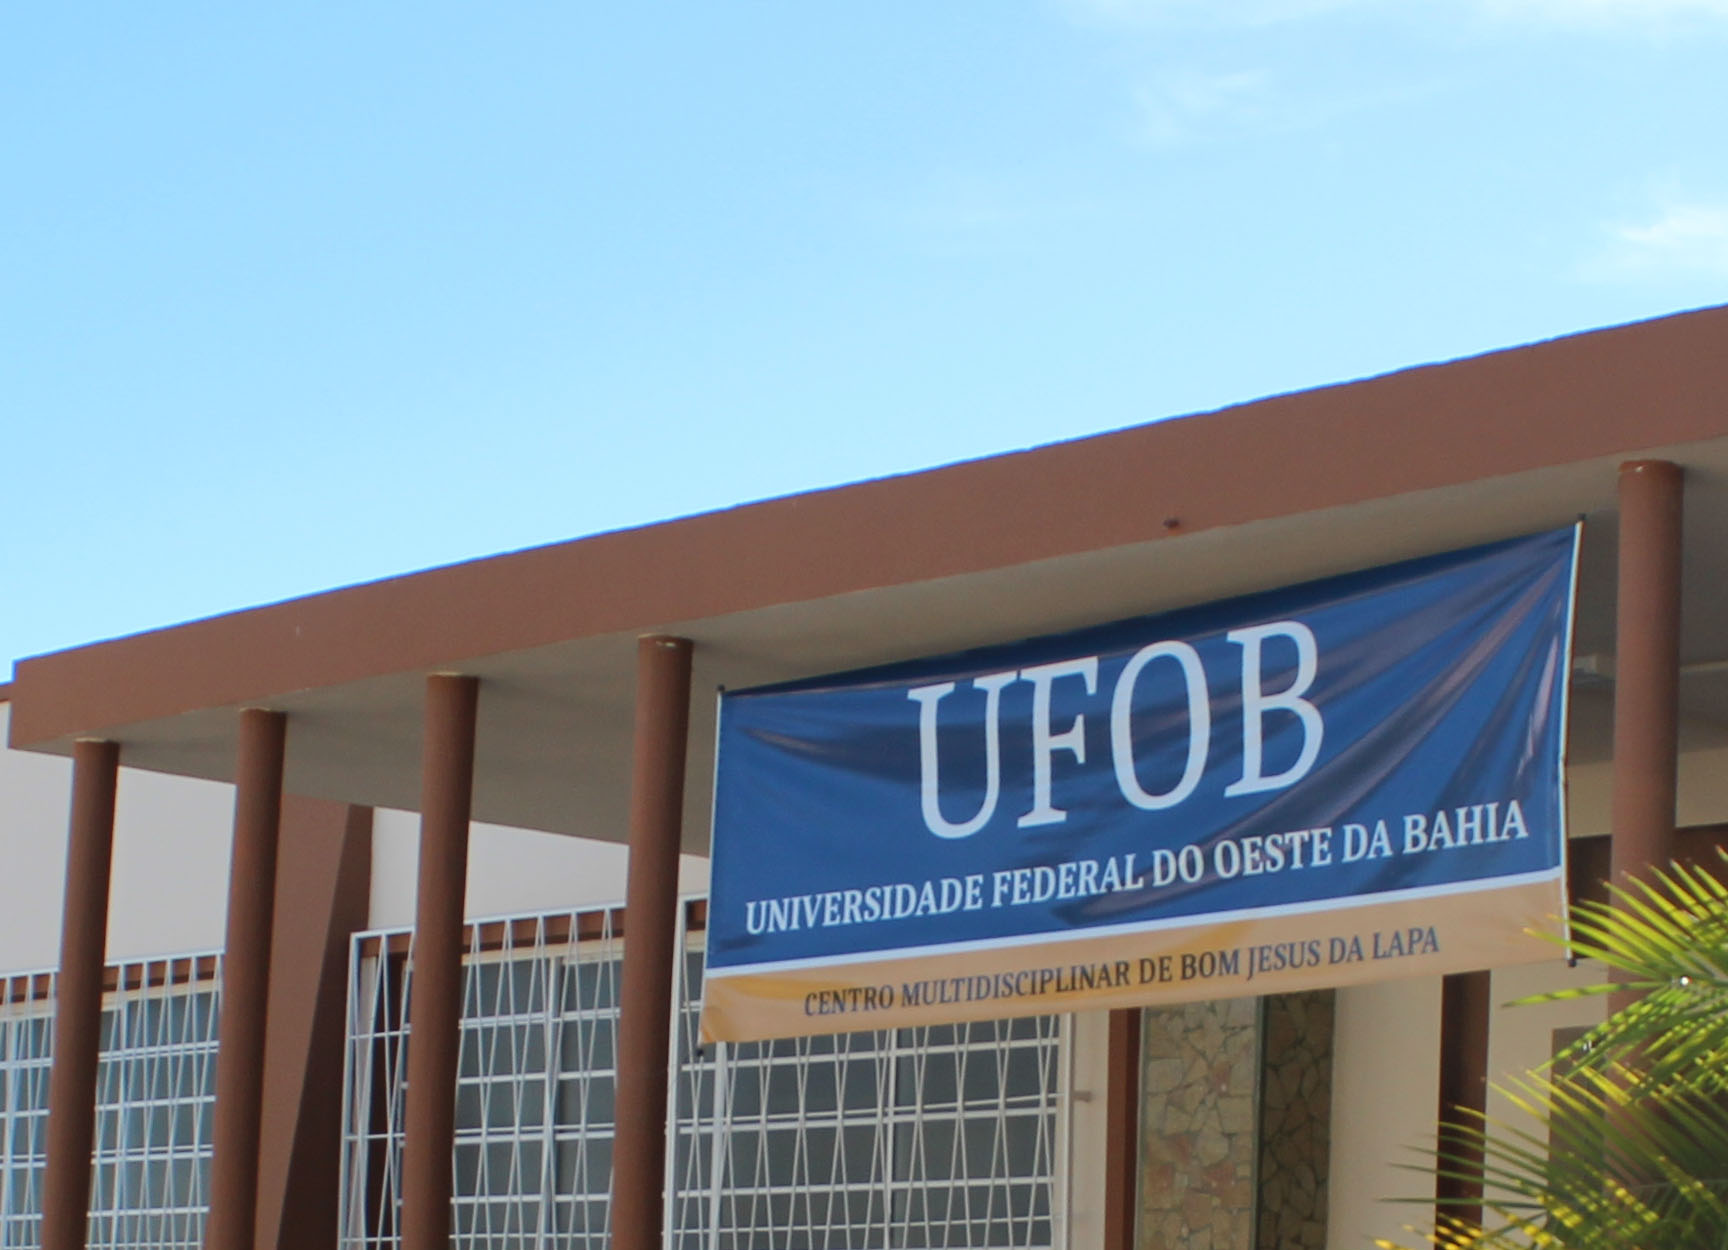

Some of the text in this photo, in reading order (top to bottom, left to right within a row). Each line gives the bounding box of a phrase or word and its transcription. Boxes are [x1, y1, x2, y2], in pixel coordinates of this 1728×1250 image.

[907, 620, 1324, 838] UFOB
[746, 799, 1529, 935] UNIVERSIDADE FEDERAL DO OESTE DA BAHIA
[804, 925, 1441, 1017] CENTRO MULTIDISCIPLINAR DE BOM JESUS DA LAPA
